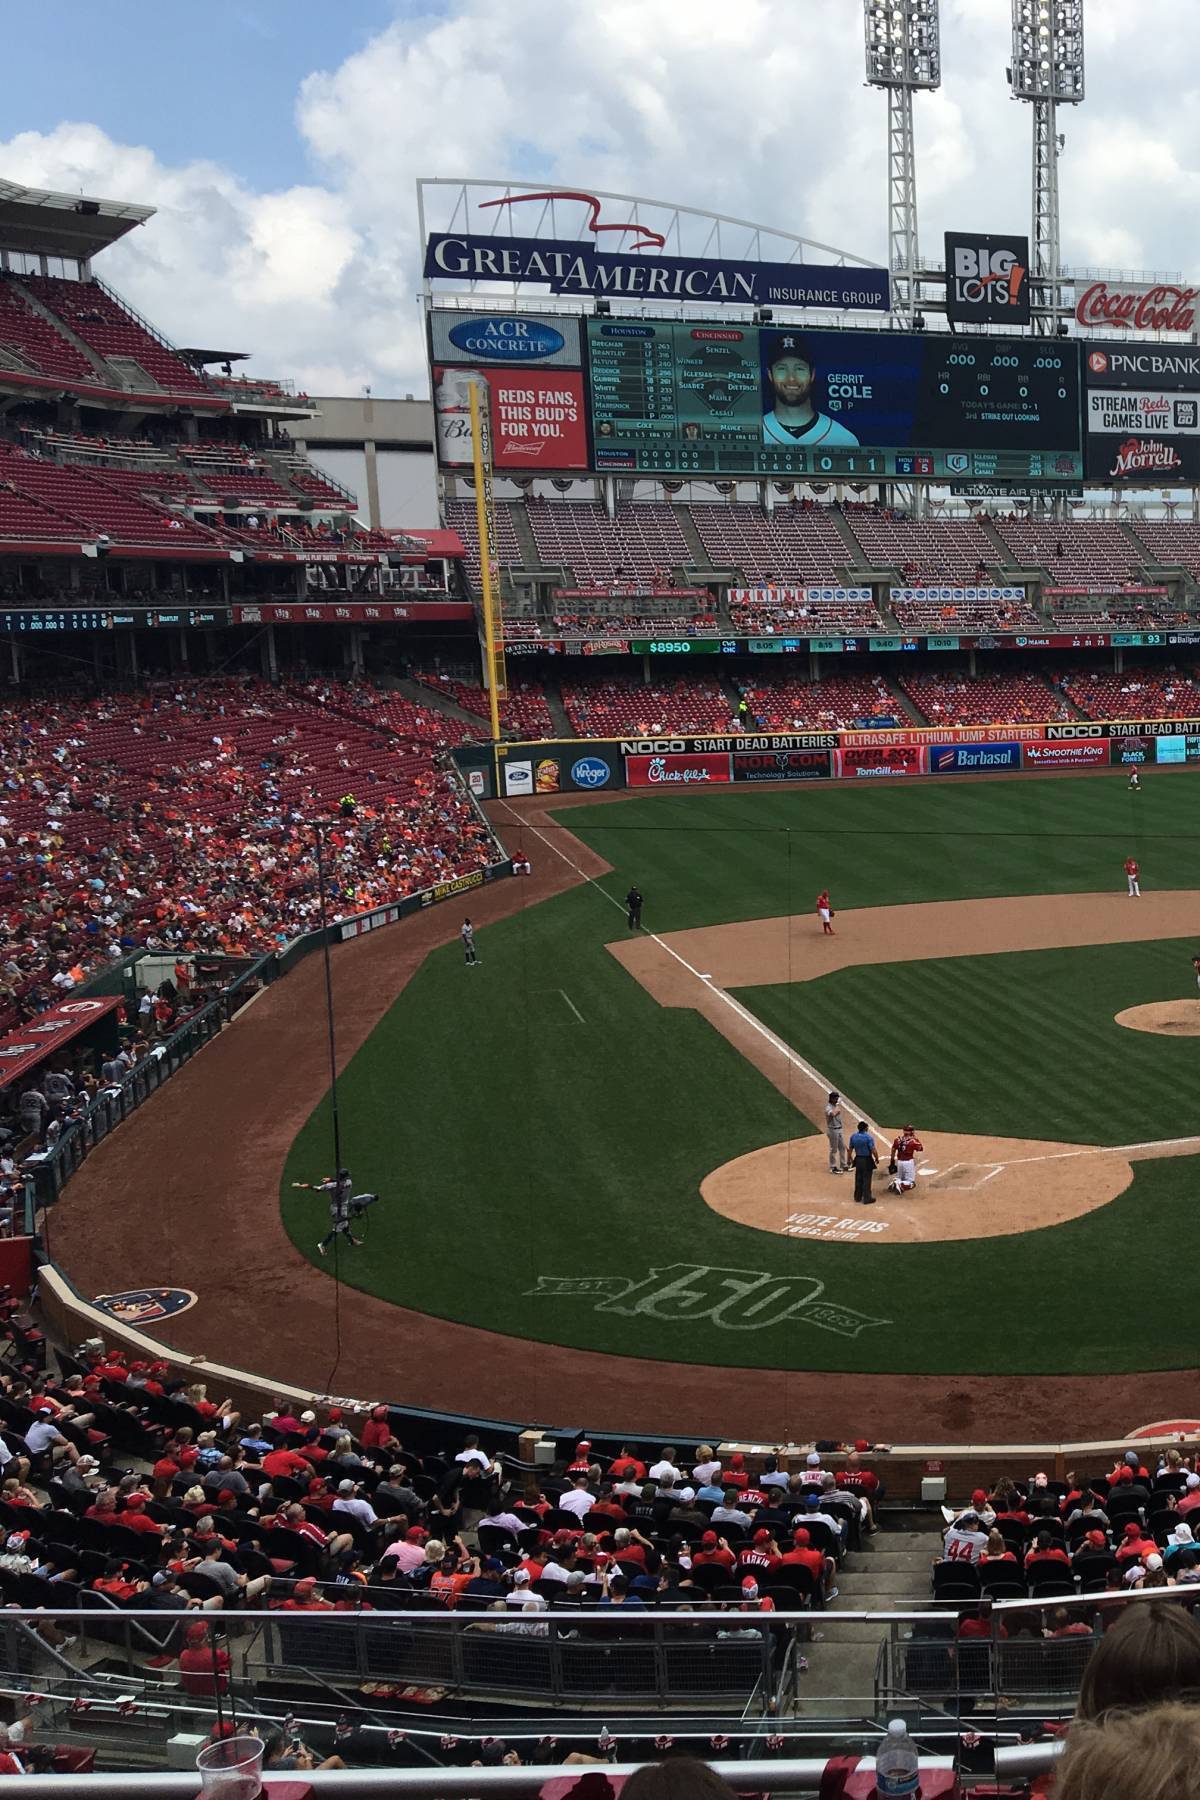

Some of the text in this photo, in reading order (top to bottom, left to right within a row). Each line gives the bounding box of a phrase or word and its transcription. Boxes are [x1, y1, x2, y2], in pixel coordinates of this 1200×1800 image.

[954, 247, 1018, 278] BIG
[769, 287, 881, 305] INSURANCE GROUP
[1076, 283, 1200, 331] Coca-Cola
[484, 321, 529, 337] ACR
[611, 327, 647, 335] HOUSTON
[696, 331, 739, 339] CINCINNATI
[466, 338, 546, 352] CONCRETE
[705, 346, 730, 354] SENZEL
[946, 354, 1062, 369] .000 .000 .000
[1109, 355, 1200, 374] PNC BANK
[827, 373, 864, 384] GERRIT
[938, 372, 991, 382] HR RBI
[828, 385, 872, 399] COLE
[940, 383, 1067, 398] 0 0 0 0
[498, 389, 577, 407] REDS FANS,
[1092, 395, 1171, 414] STREAM Reds
[499, 406, 577, 421] THIS BUD'S
[1177, 403, 1194, 412] FOX
[981, 413, 1040, 422] STRIKE OUT LOOKING
[1103, 413, 1168, 429] GAMES LIVE
[1177, 415, 1194, 424] GO
[501, 422, 564, 438] FOR YOU.
[1136, 440, 1163, 454] John
[821, 457, 875, 471] 0 1 1
[1109, 447, 1182, 476] Morrell
[954, 487, 1078, 497] ULTIMATE AIR SHUTTLE
[1148, 634, 1160, 644] 93
[650, 642, 691, 653] $8950
[844, 727, 1043, 746] ULTRASAFE LITHIUM JUMP STARTERS.
[1048, 725, 1102, 738] NOCO
[1109, 724, 1144, 736] START
[1147, 723, 1172, 734] DEAD
[620, 735, 838, 755] NOCO START DEAD BATTERIES.
[1042, 746, 1104, 758] SMOOTHIE KING
[845, 749, 883, 758] OVER
[957, 749, 1012, 766] Barbasol
[512, 772, 528, 780] Ford
[576, 763, 606, 783] Kroger
[746, 770, 820, 779] Technology Solutions
[856, 766, 906, 776] TomGill.com
[434, 872, 483, 897] MIKE CASTRUCCI
[785, 1213, 890, 1233] VOTE REDS
[781, 1225, 860, 1239] reds.com
[950, 1540, 975, 1561] 44
[742, 1555, 770, 1568] LARKIN
